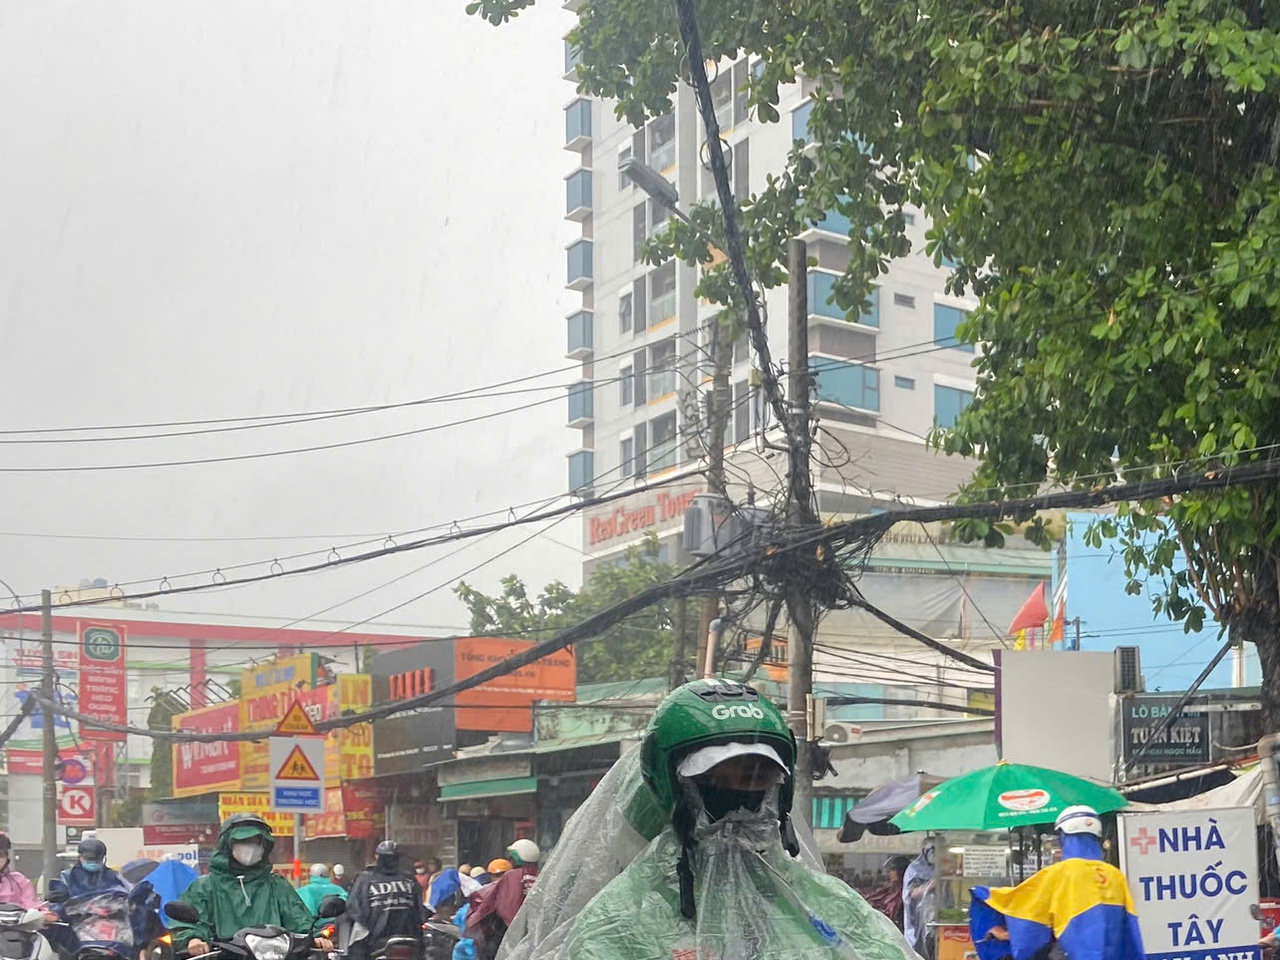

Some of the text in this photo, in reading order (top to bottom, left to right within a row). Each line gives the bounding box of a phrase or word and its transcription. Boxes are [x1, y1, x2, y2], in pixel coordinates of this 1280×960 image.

[657, 488, 703, 523] Tow
[712, 703, 764, 720] Grab
[1131, 704, 1148, 718] LÒ
[1170, 723, 1201, 746] KIỆT
[1158, 818, 1226, 853] NHÀ
[1139, 860, 1248, 901] THUỐC
[1167, 913, 1224, 947] TÂY
